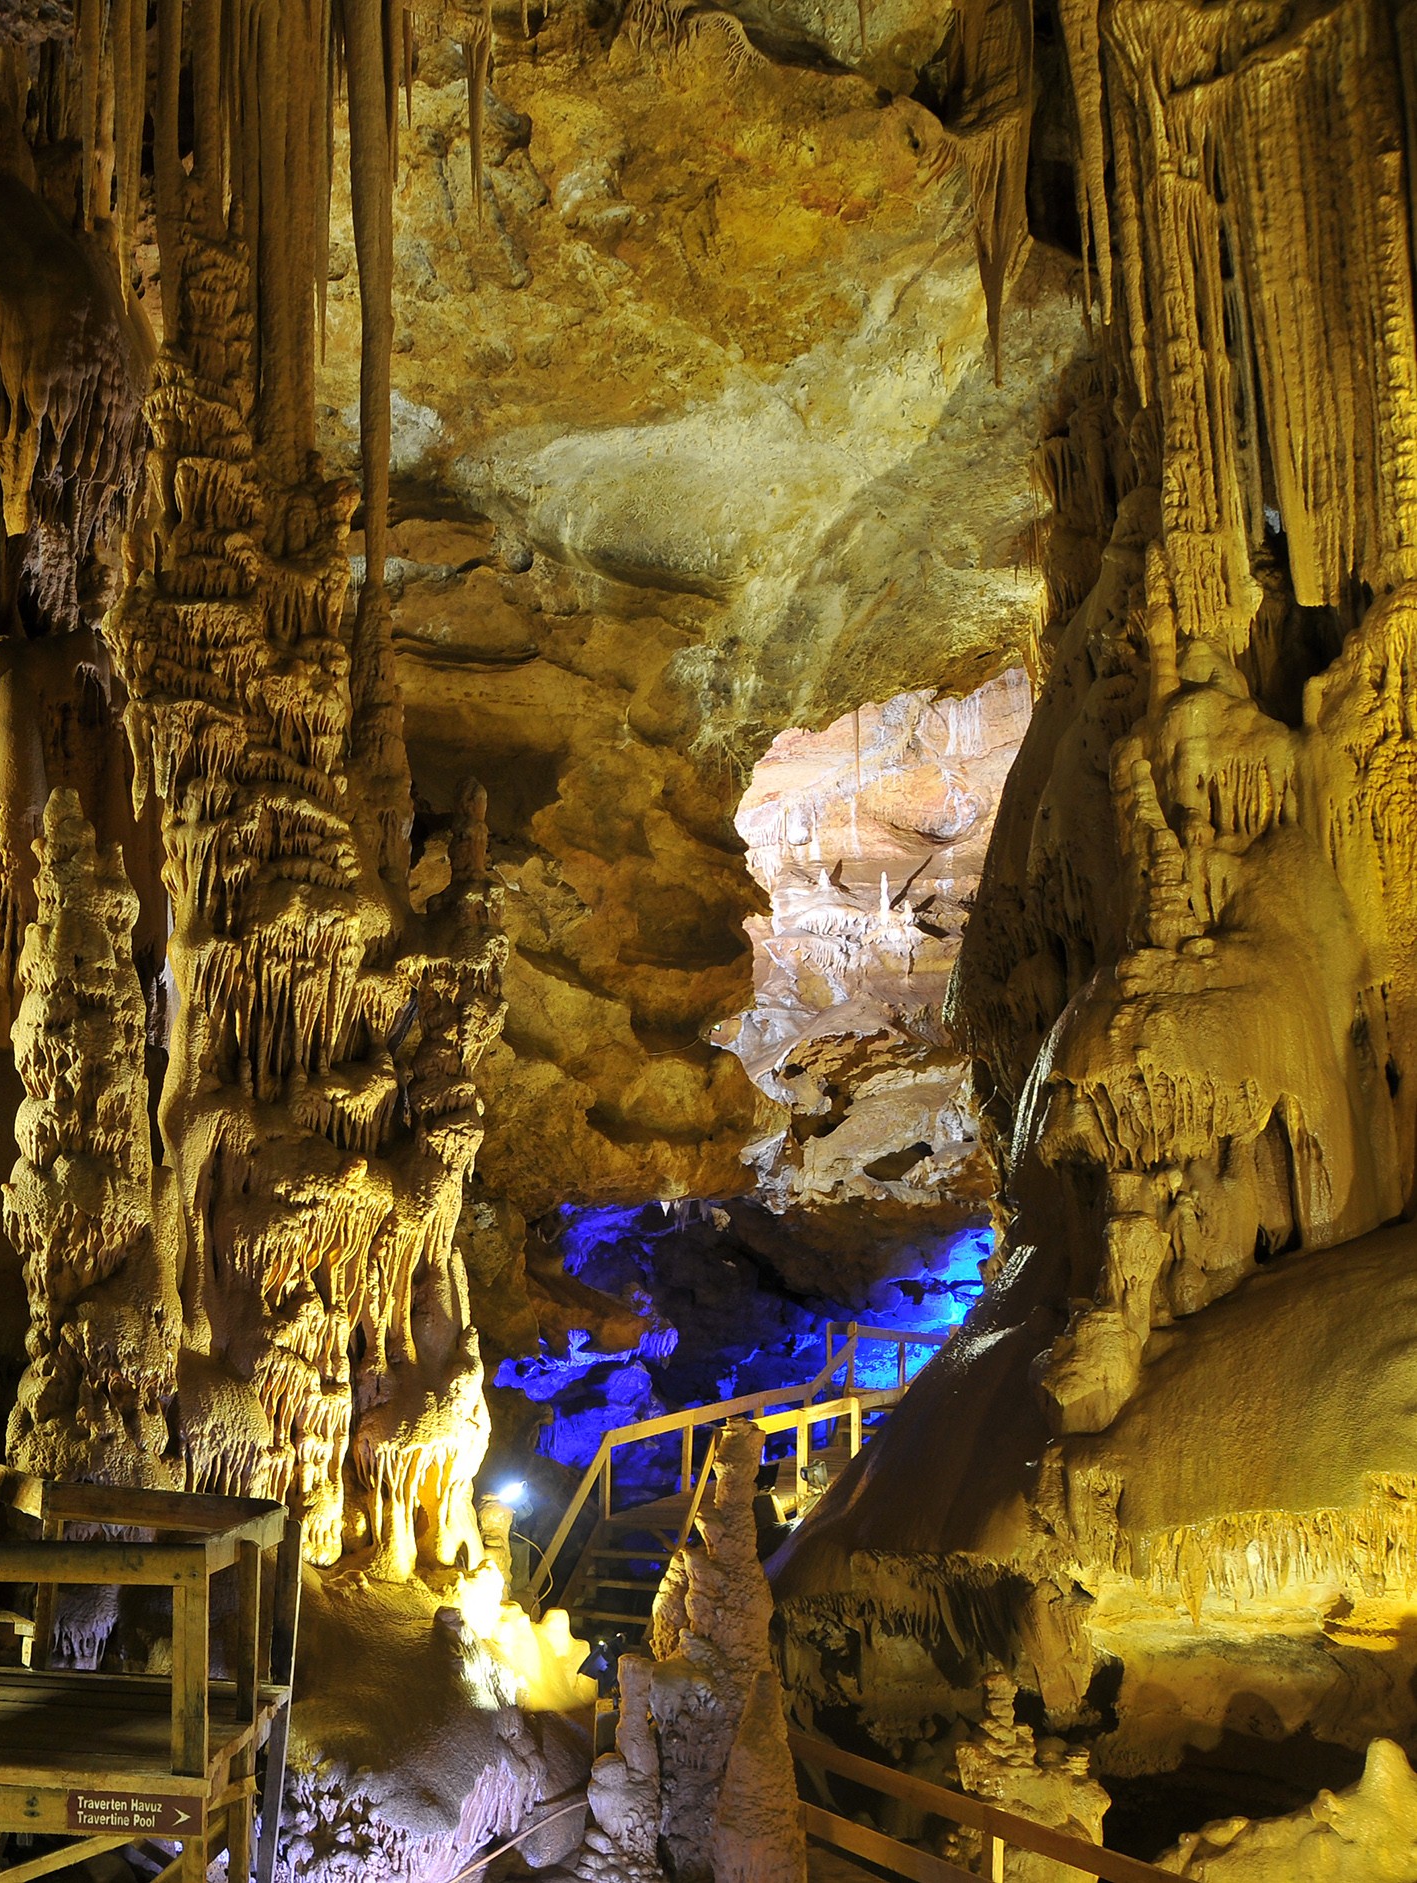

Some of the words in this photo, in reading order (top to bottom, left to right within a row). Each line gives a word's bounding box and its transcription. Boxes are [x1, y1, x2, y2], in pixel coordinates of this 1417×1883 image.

[77, 1796, 127, 1811] Traverten
[131, 1798, 162, 1813] Havuz
[77, 1811, 130, 1826] Travertine
[133, 1814, 155, 1827] Pool
